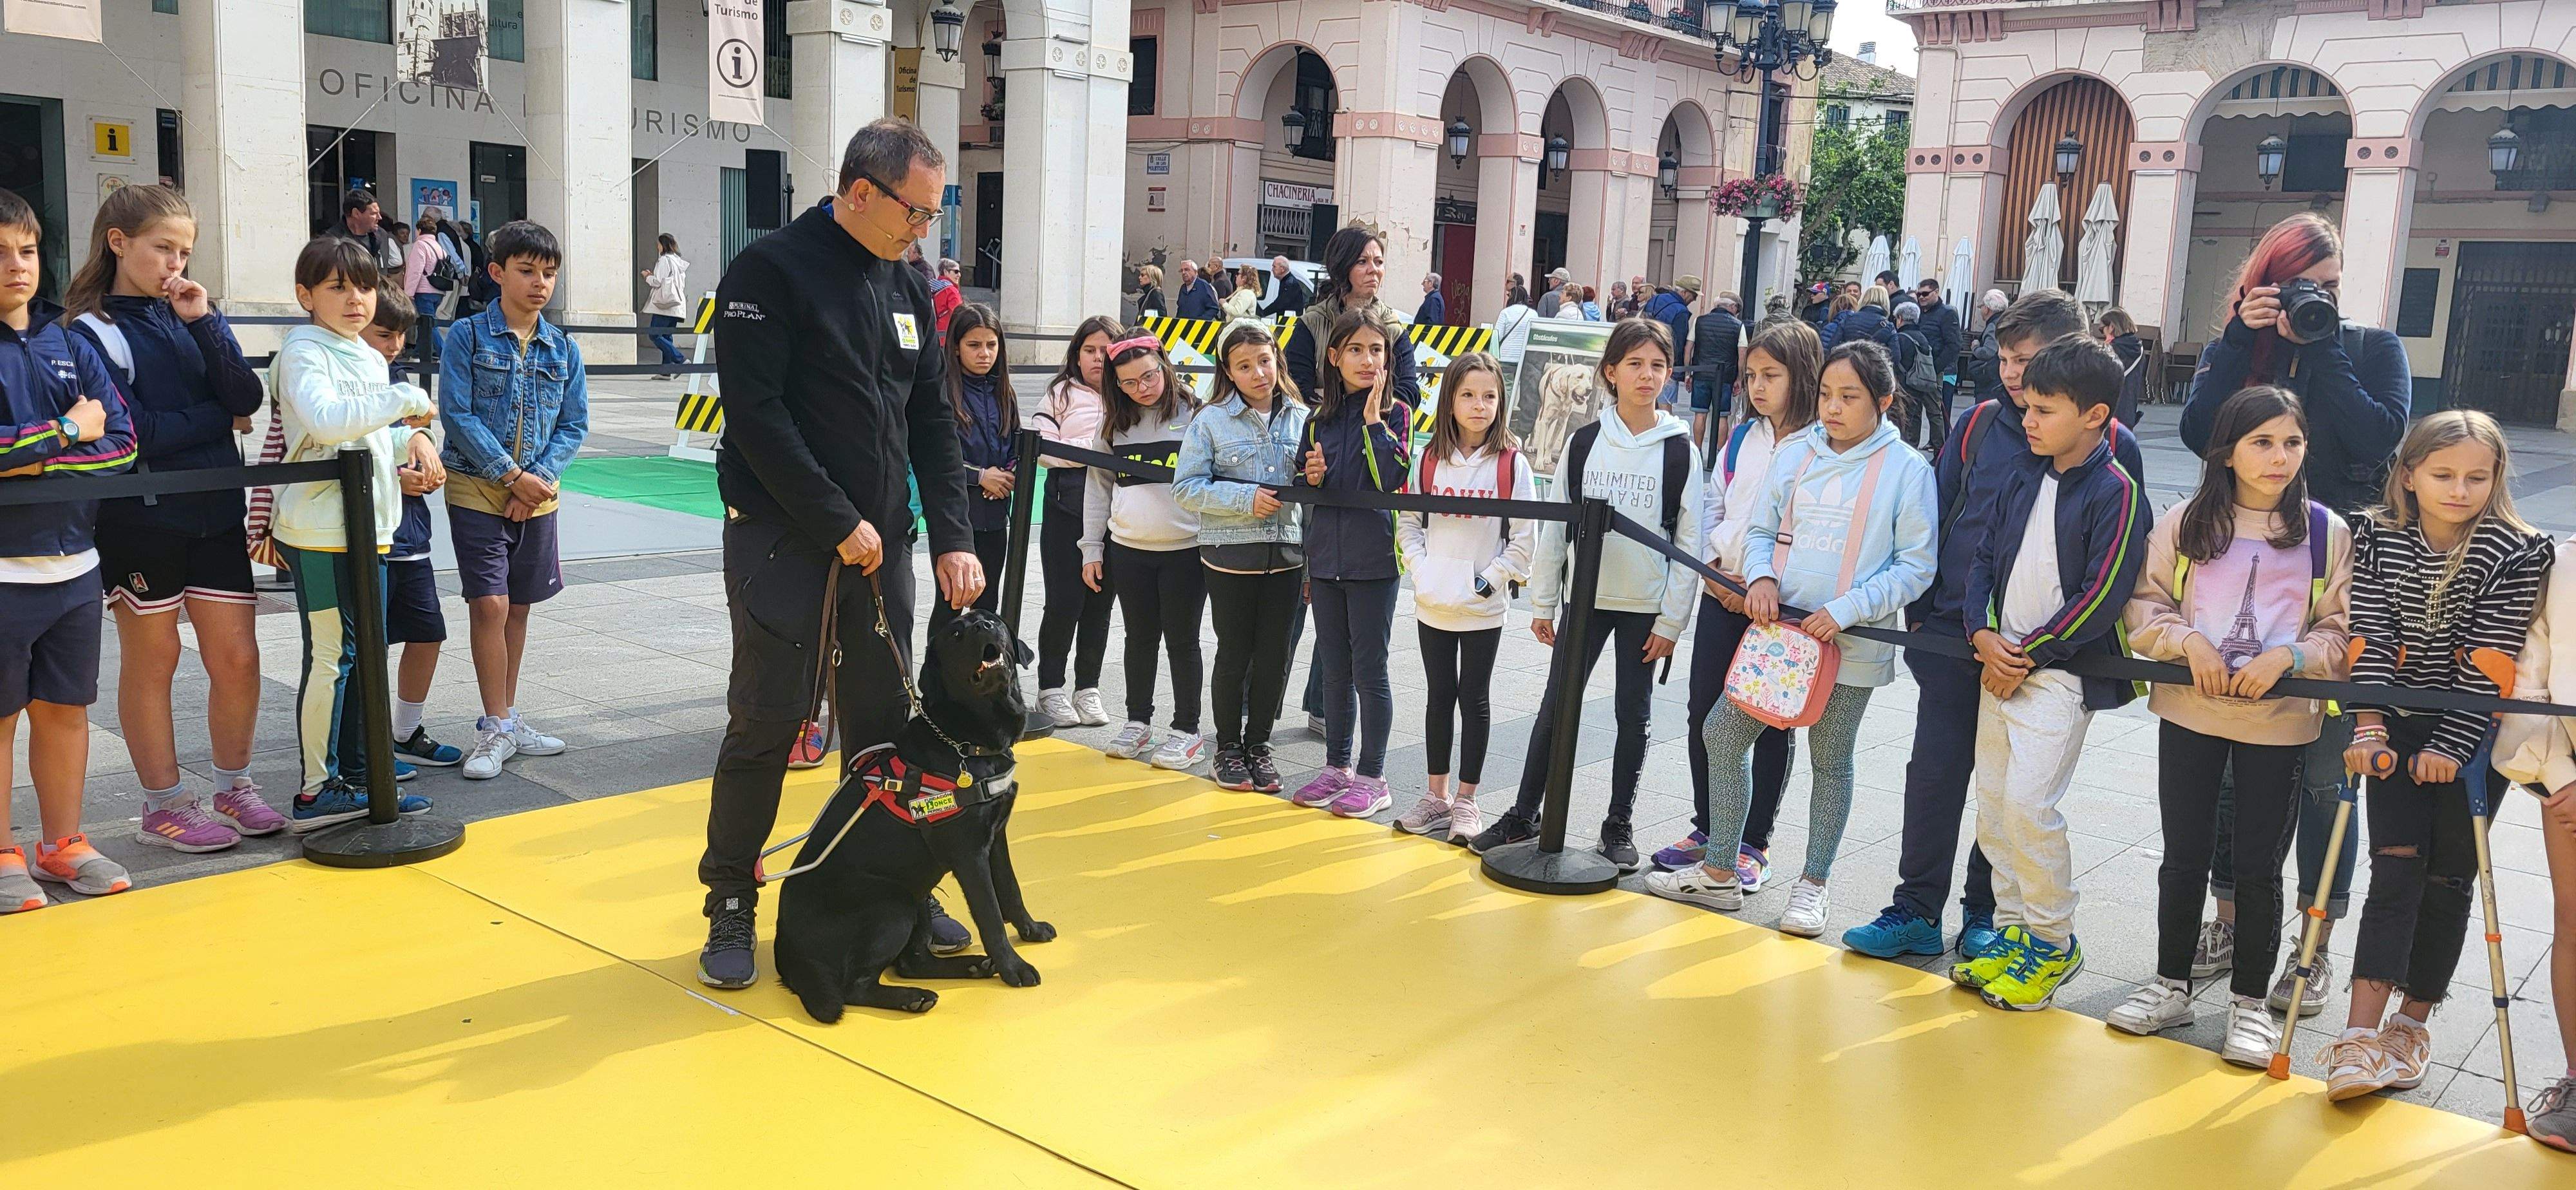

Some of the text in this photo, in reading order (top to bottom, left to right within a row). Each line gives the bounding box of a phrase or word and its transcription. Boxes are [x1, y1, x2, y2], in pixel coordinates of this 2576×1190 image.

[714, 3, 758, 20] Turismo
[319, 68, 495, 114] OFICINA
[1533, 333, 1558, 343] Obstáculos
[1583, 469, 1656, 491] UNLIMITED
[934, 798, 953, 807] ONCE
